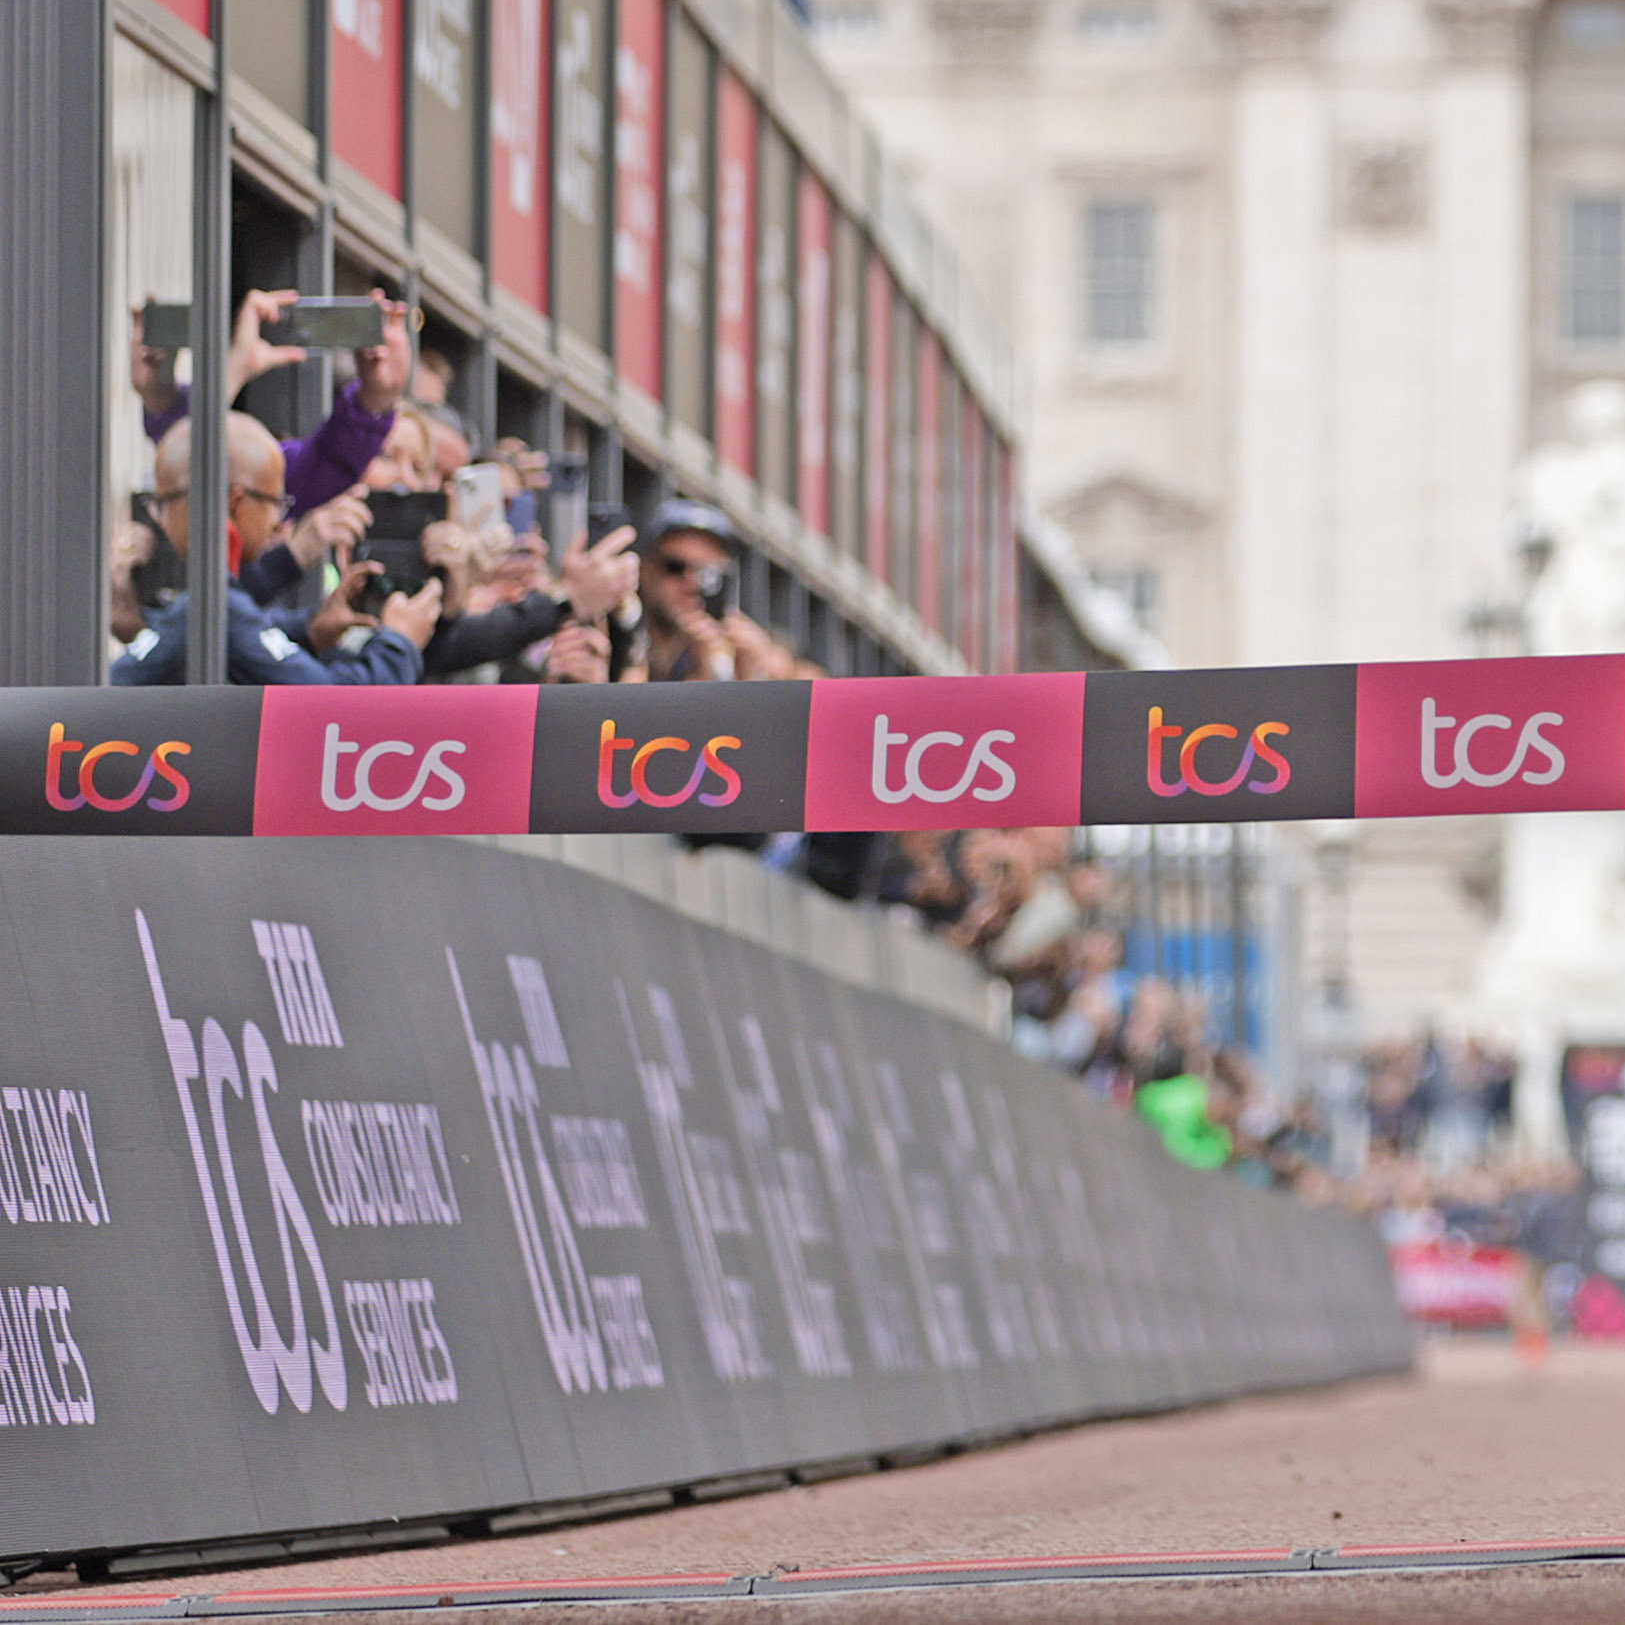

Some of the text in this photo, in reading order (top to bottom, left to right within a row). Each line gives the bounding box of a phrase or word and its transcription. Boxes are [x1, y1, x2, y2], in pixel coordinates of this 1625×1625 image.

[45, 721, 191, 812] tcs
[320, 722, 467, 812] tcs
[597, 719, 742, 808] tcs
[871, 713, 1016, 804] tcs
[1146, 706, 1292, 797] tcs
[1420, 697, 1566, 789] tcs
[251, 919, 344, 1048] TATA
[134, 907, 348, 1415] tcs
[342, 1278, 459, 1408] SERVICES
